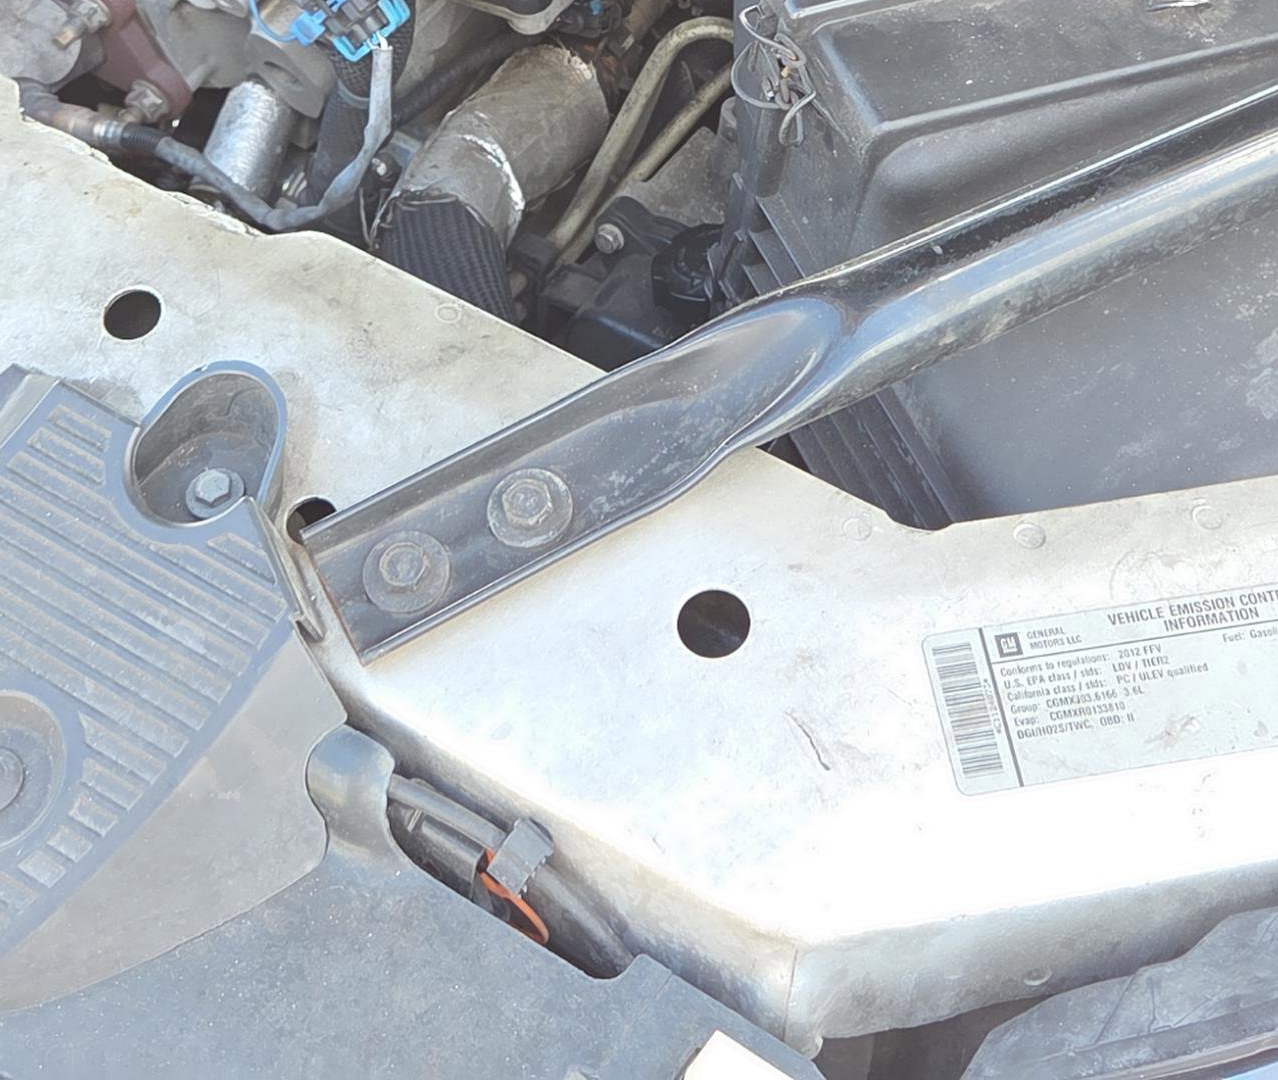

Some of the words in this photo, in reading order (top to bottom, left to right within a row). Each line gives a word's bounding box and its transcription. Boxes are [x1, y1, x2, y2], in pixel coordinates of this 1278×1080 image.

[1107, 607, 1167, 625] VEHICLE
[1168, 596, 1236, 616] EMISSION
[1163, 607, 1259, 631] INFORMATION
[1026, 627, 1064, 639] GENERAL
[1030, 637, 1064, 649] MOTORS
[1067, 635, 1081, 644] LLC
[1222, 632, 1245, 642] Fuel:
[1000, 662, 1042, 676] Conforms
[1045, 661, 1054, 669] to
[1056, 652, 1110, 669] regulations:
[1117, 647, 1140, 657] 2012
[1143, 644, 1161, 653] FFV
[1026, 675, 1045, 685] EPA
[1047, 670, 1070, 681] class
[1112, 661, 1132, 671] LDV
[1142, 655, 1169, 667] TIER2
[1006, 687, 1050, 701] California
[1052, 683, 1075, 694] class
[1116, 674, 1129, 683] PC
[1139, 669, 1164, 680] ULEV
[1166, 661, 1208, 677] qualified
[1010, 702, 1041, 714] Group:
[1123, 685, 1144, 696] 3.6L
[1014, 715, 1039, 727] Evap:
